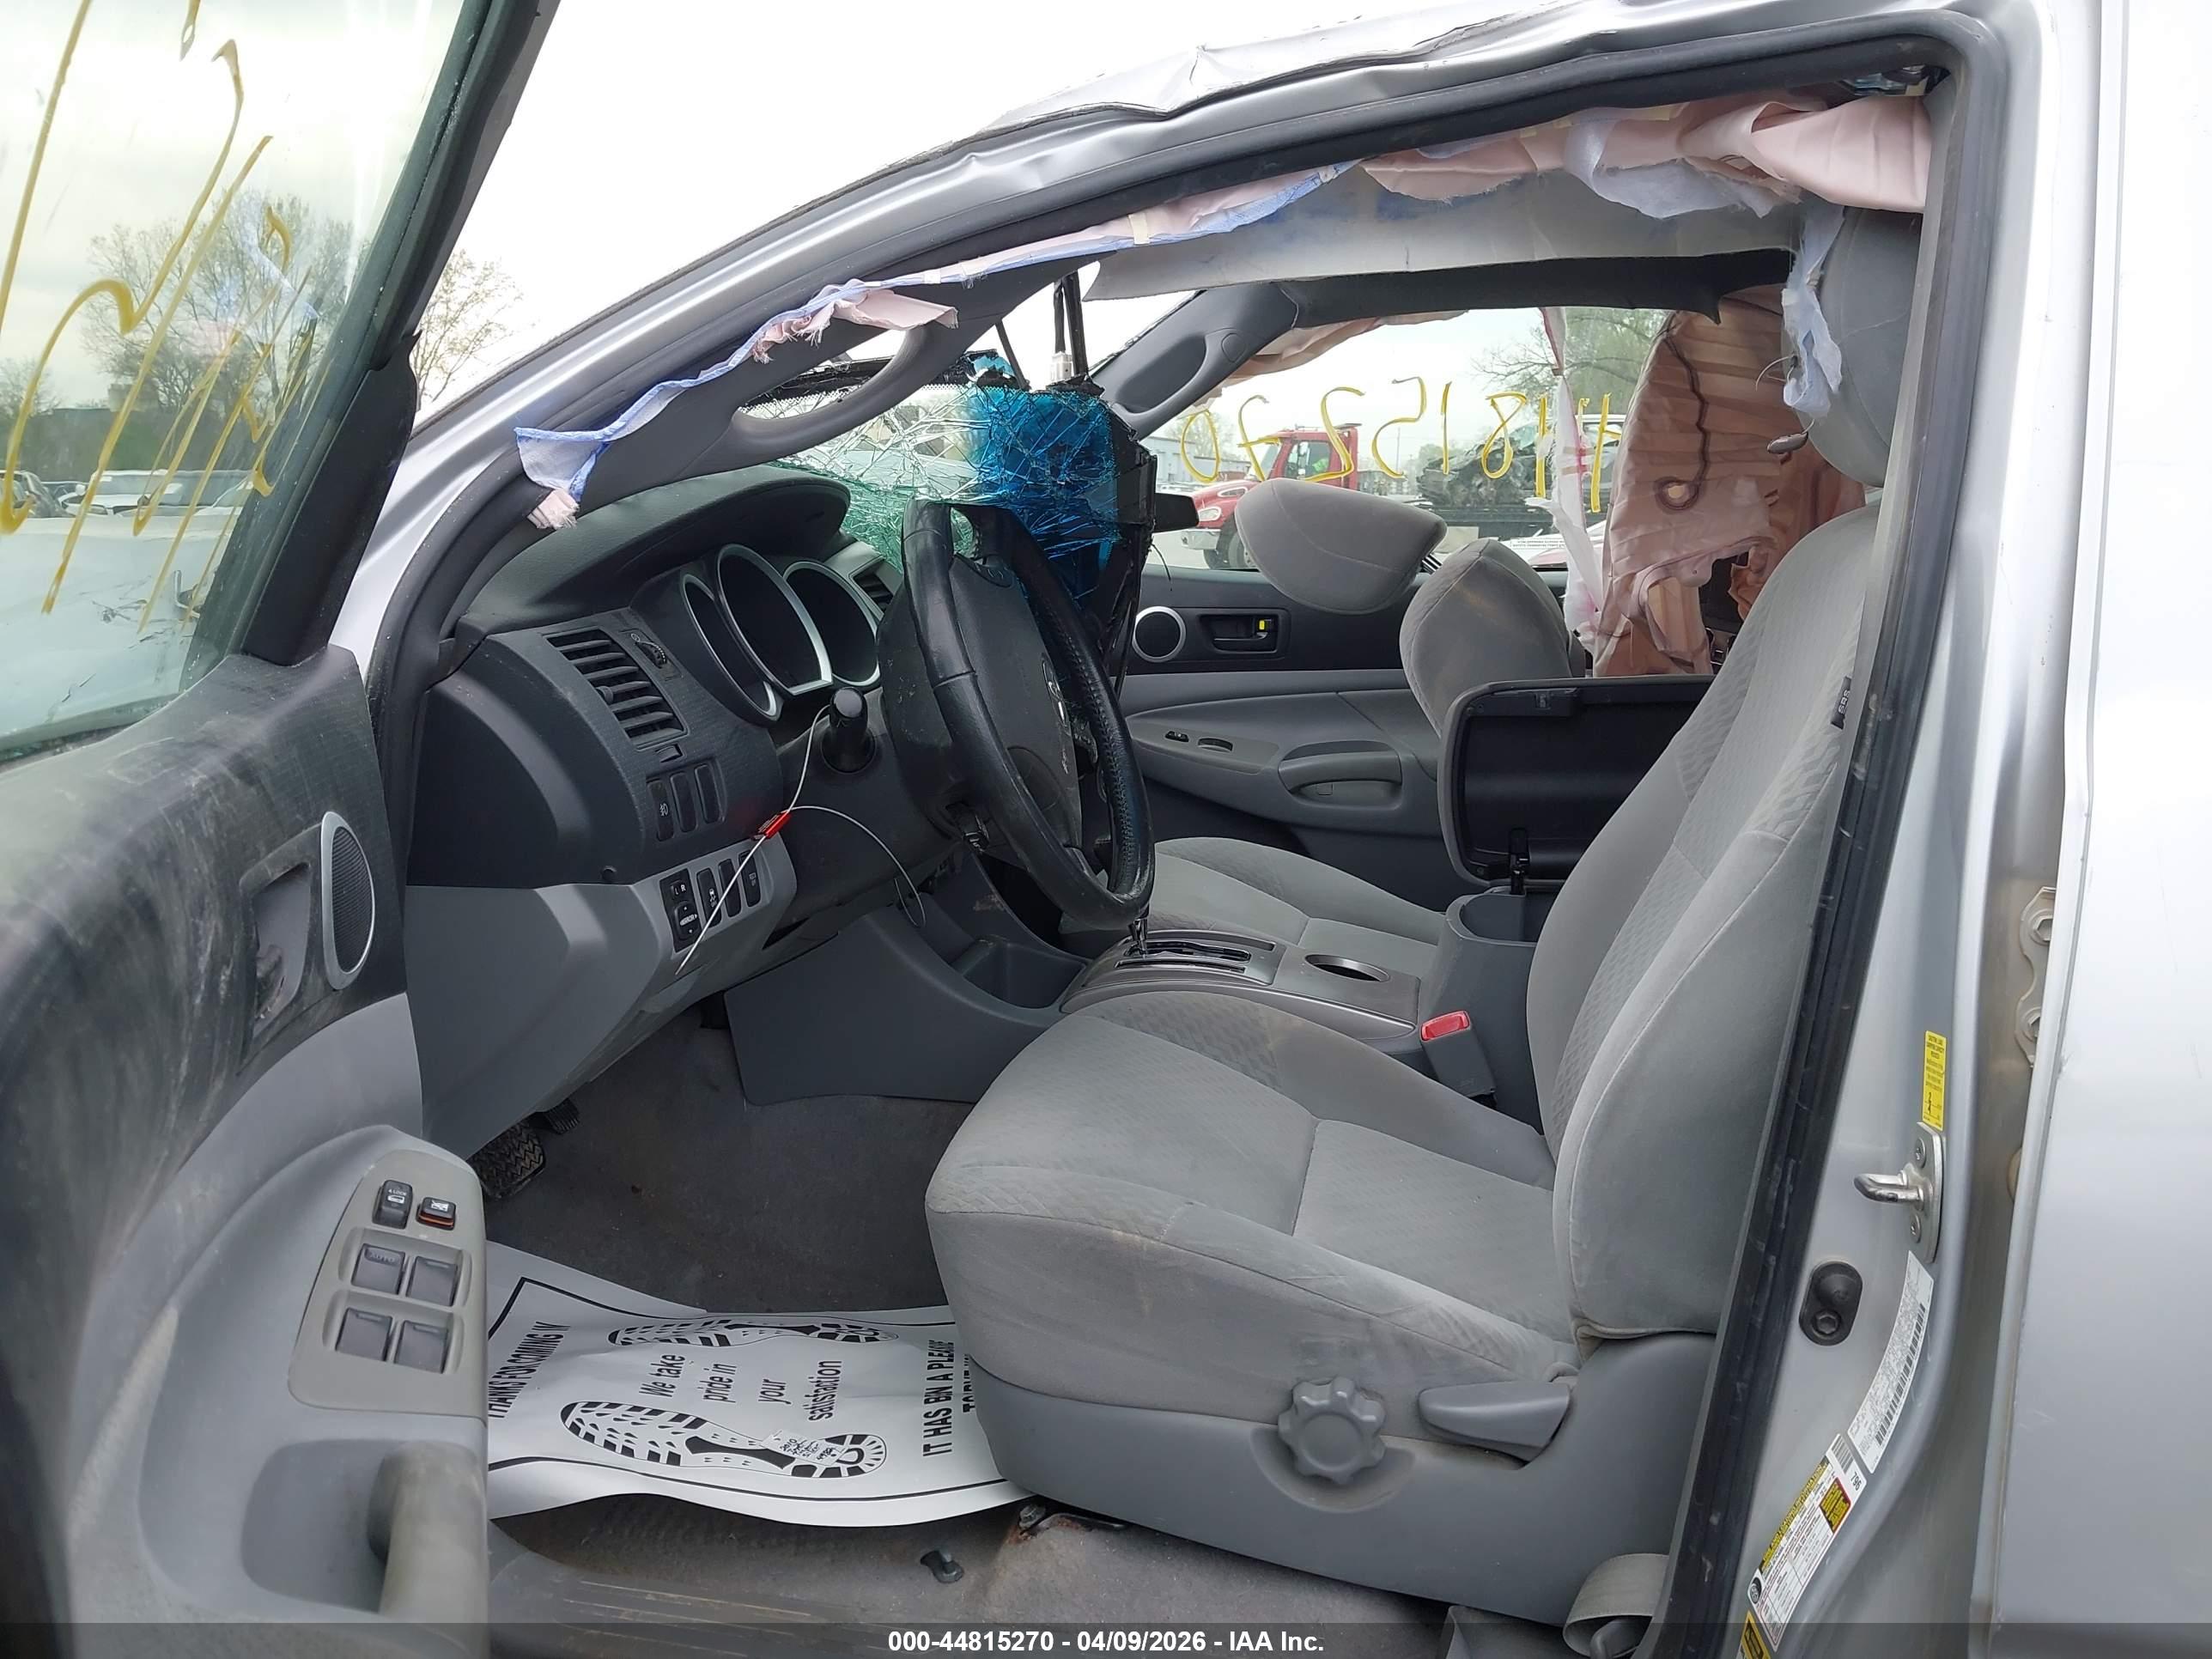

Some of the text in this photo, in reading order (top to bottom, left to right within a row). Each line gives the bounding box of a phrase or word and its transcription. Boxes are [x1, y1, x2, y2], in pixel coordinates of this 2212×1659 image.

[1838, 690, 1850, 715] SRS
[507, 1334, 564, 1364] COMING
[492, 1363, 542, 1379] FOR
[639, 1354, 685, 1397] We take
[697, 1363, 737, 1403] pride in
[927, 1372, 954, 1381] A
[758, 1378, 792, 1405] your
[802, 1360, 842, 1422] satisfaction
[923, 1407, 952, 1438] HAS
[922, 1443, 952, 1456] IT
[1850, 1471, 1863, 1491] 796
